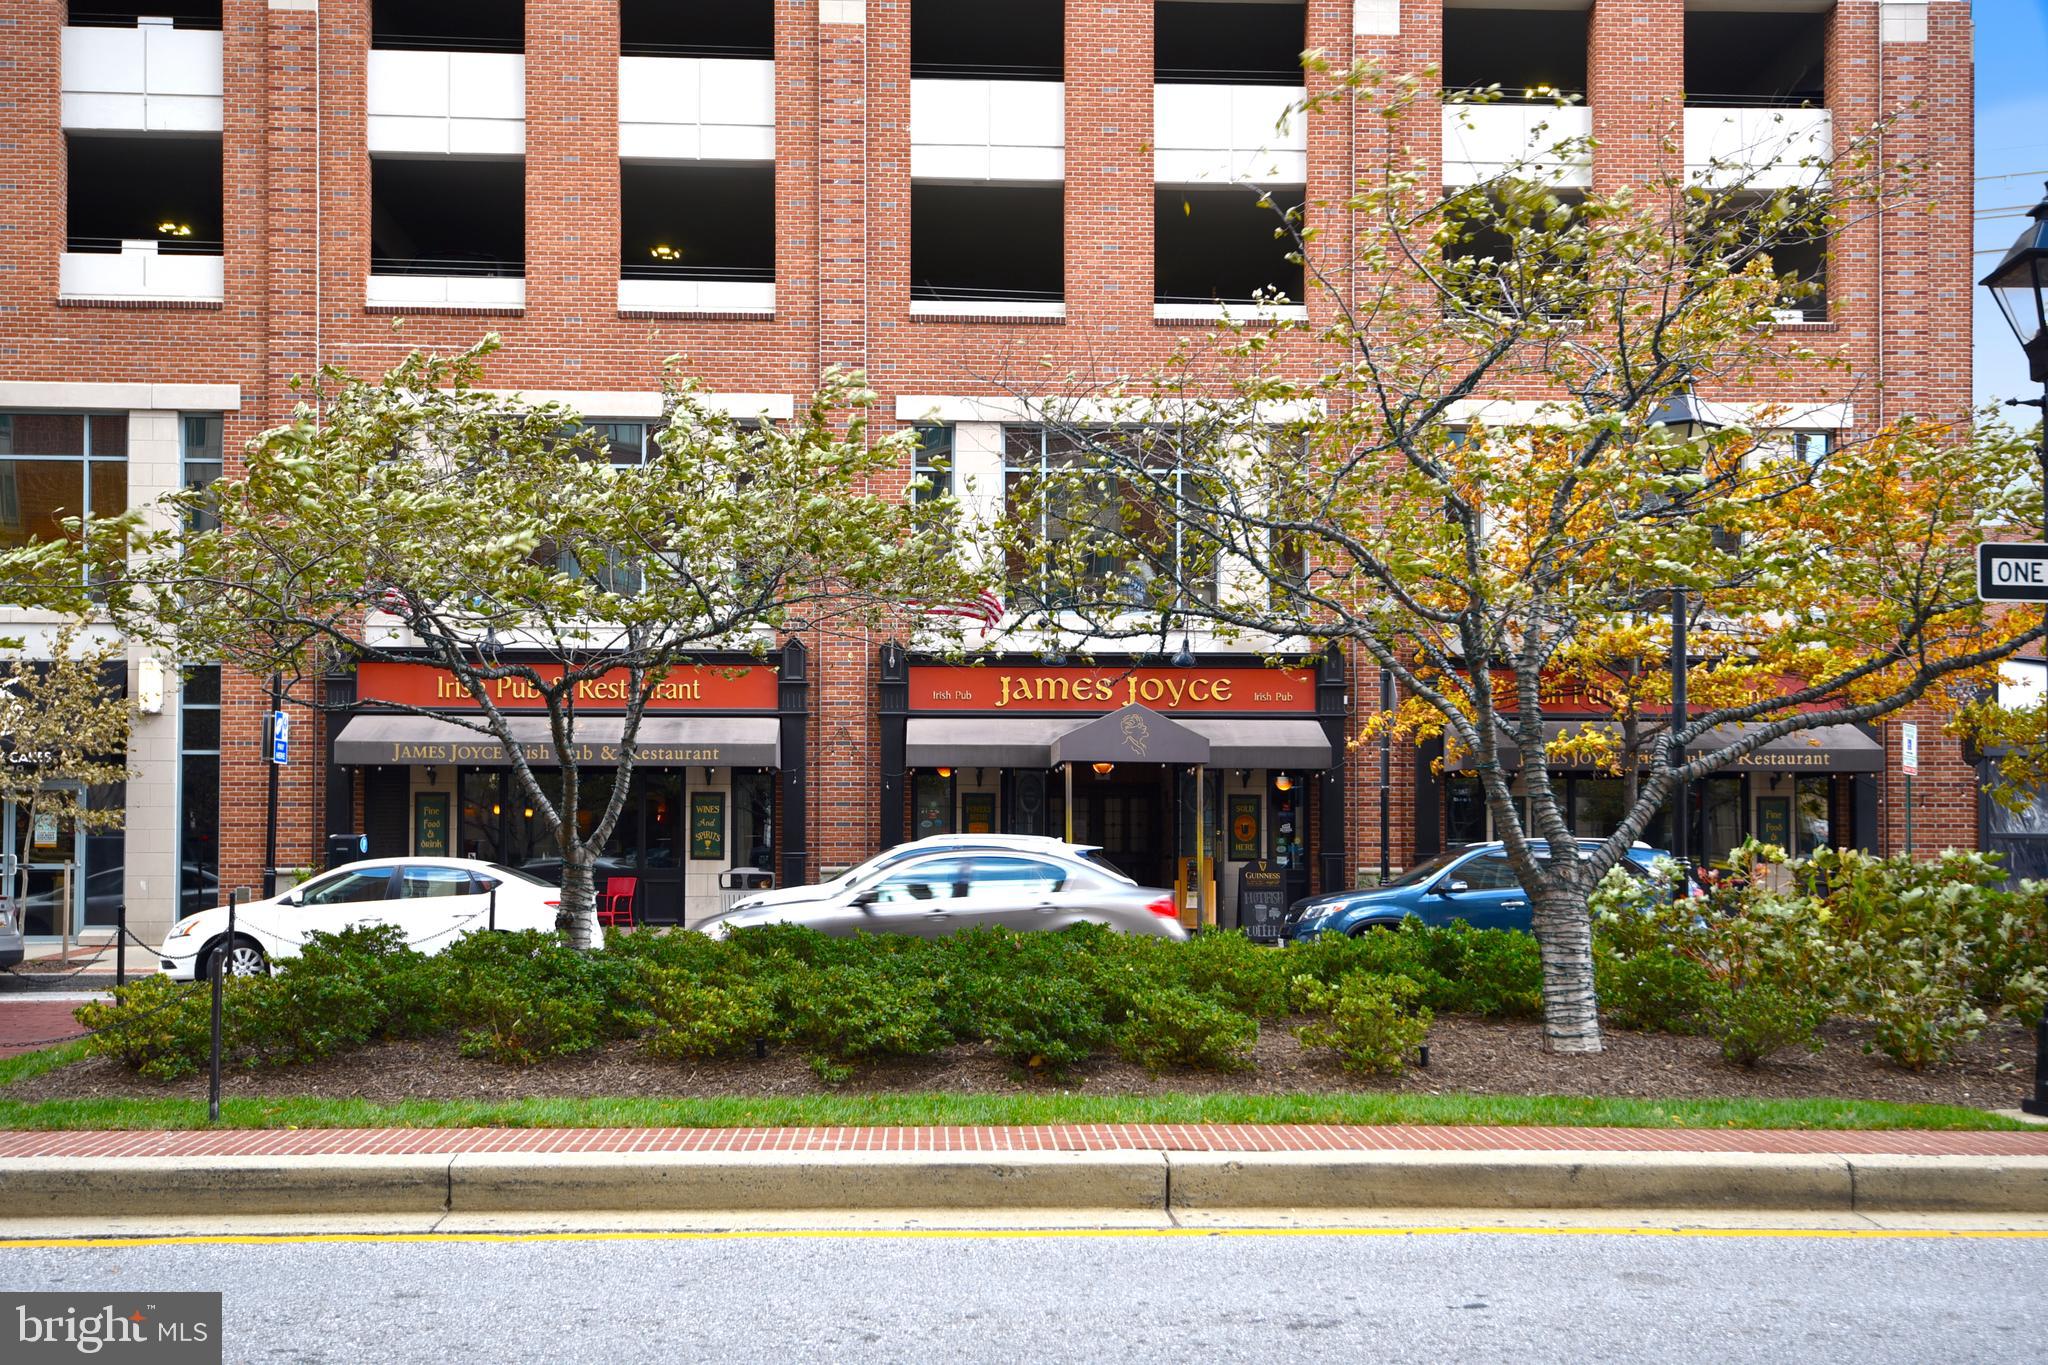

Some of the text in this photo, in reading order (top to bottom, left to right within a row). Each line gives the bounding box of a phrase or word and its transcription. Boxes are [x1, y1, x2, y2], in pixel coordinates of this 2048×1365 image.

[1998, 561, 2044, 583] ONE
[438, 676, 485, 698] Iris
[933, 690, 972, 700] Irish Pub
[1254, 691, 1293, 701] Irish Pub
[392, 743, 446, 762] JAMES
[449, 744, 503, 763] JOYCE
[601, 745, 617, 760] &
[424, 806, 440, 816] Fine
[695, 805, 720, 813] WINES
[424, 819, 441, 829] Food
[697, 818, 716, 827] And
[695, 831, 721, 842] SPIRITS
[1235, 843, 1256, 851] HERE
